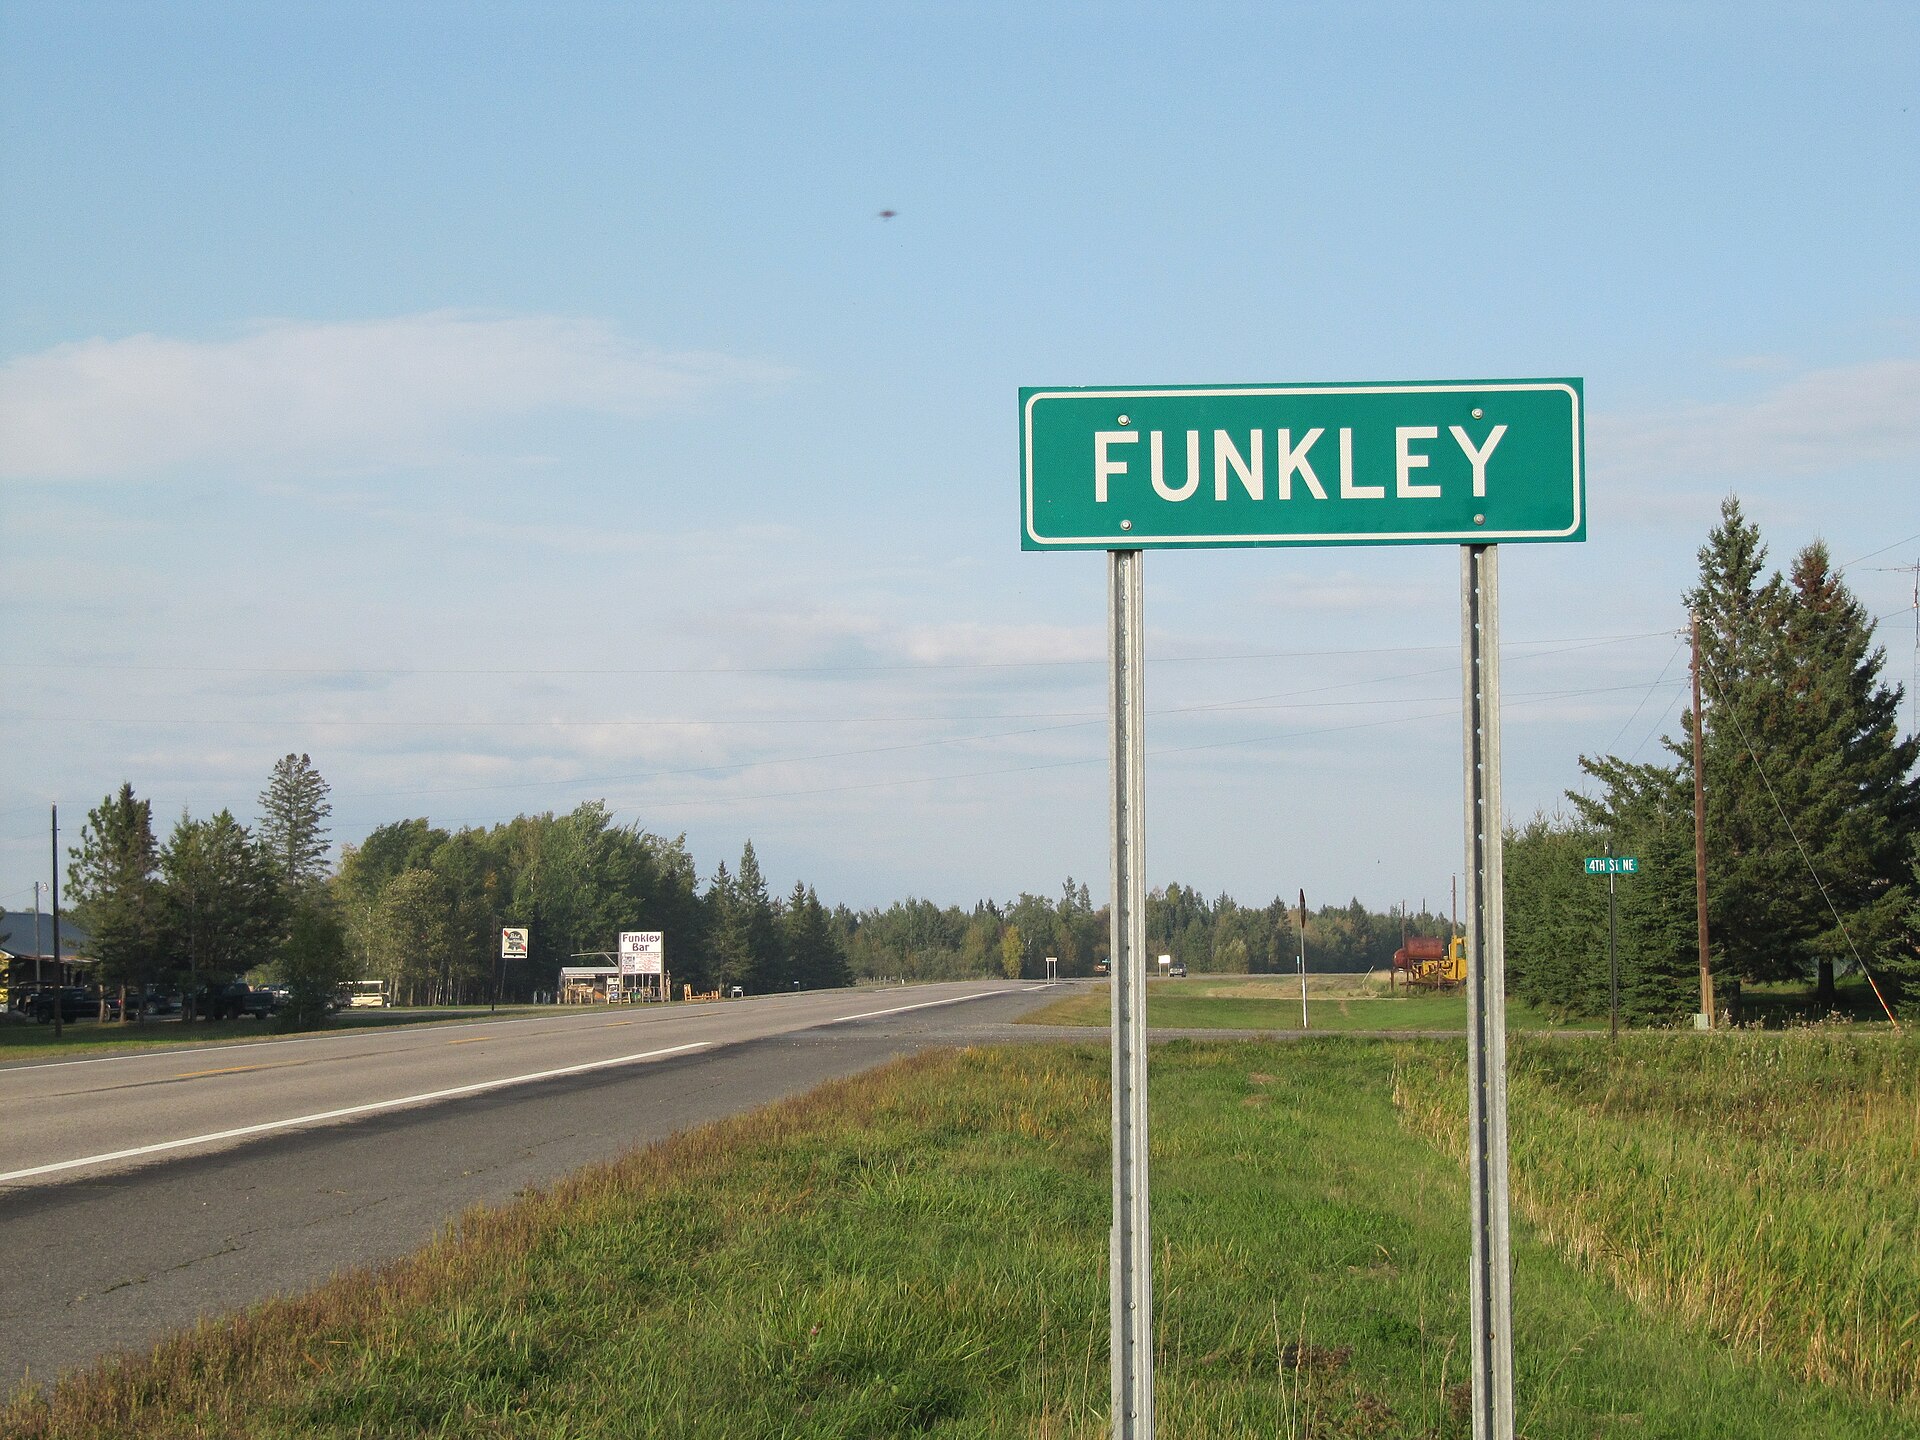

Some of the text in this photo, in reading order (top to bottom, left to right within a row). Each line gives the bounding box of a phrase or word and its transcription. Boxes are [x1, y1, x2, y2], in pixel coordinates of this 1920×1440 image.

[1095, 426, 1508, 502] FUNKLEY
[1588, 859, 1635, 871] 4TH ST NE
[622, 933, 661, 943] Funkley
[632, 942, 650, 951] Bar
